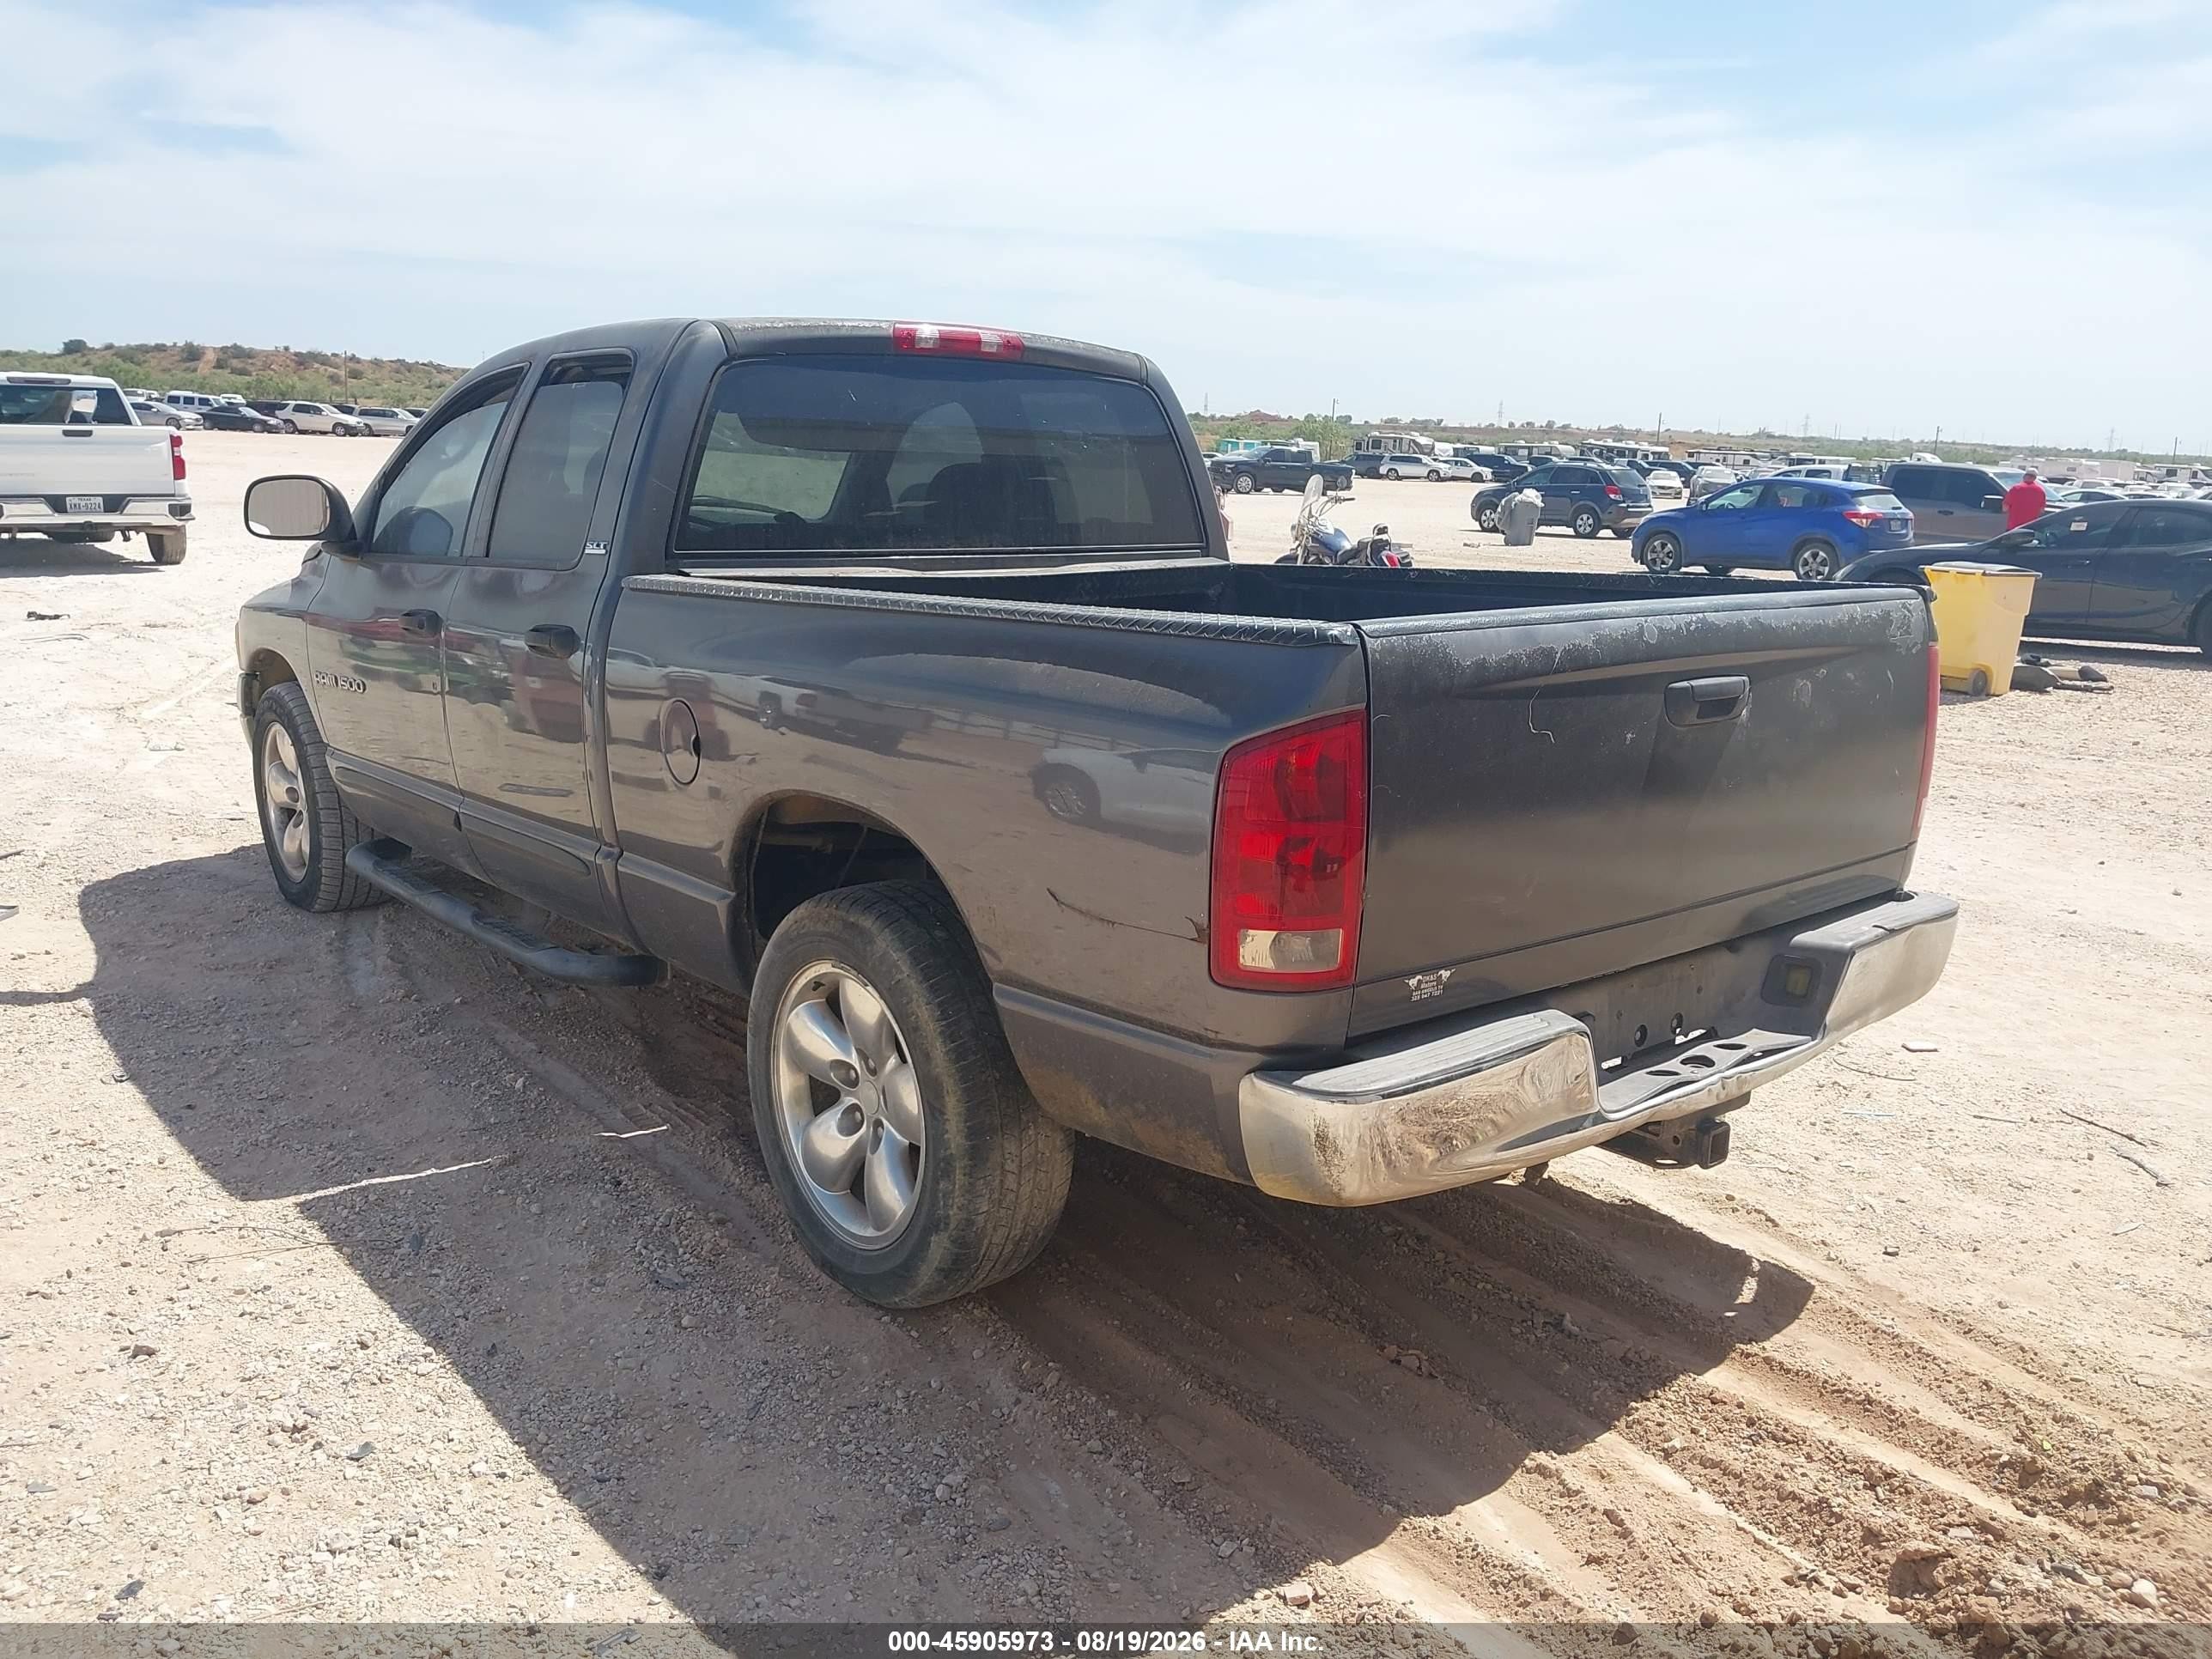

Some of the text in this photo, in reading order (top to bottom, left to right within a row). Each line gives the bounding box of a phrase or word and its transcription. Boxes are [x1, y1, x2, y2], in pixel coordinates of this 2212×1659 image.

[585, 541, 608, 550] SLT
[314, 671, 367, 694] RAM 1500
